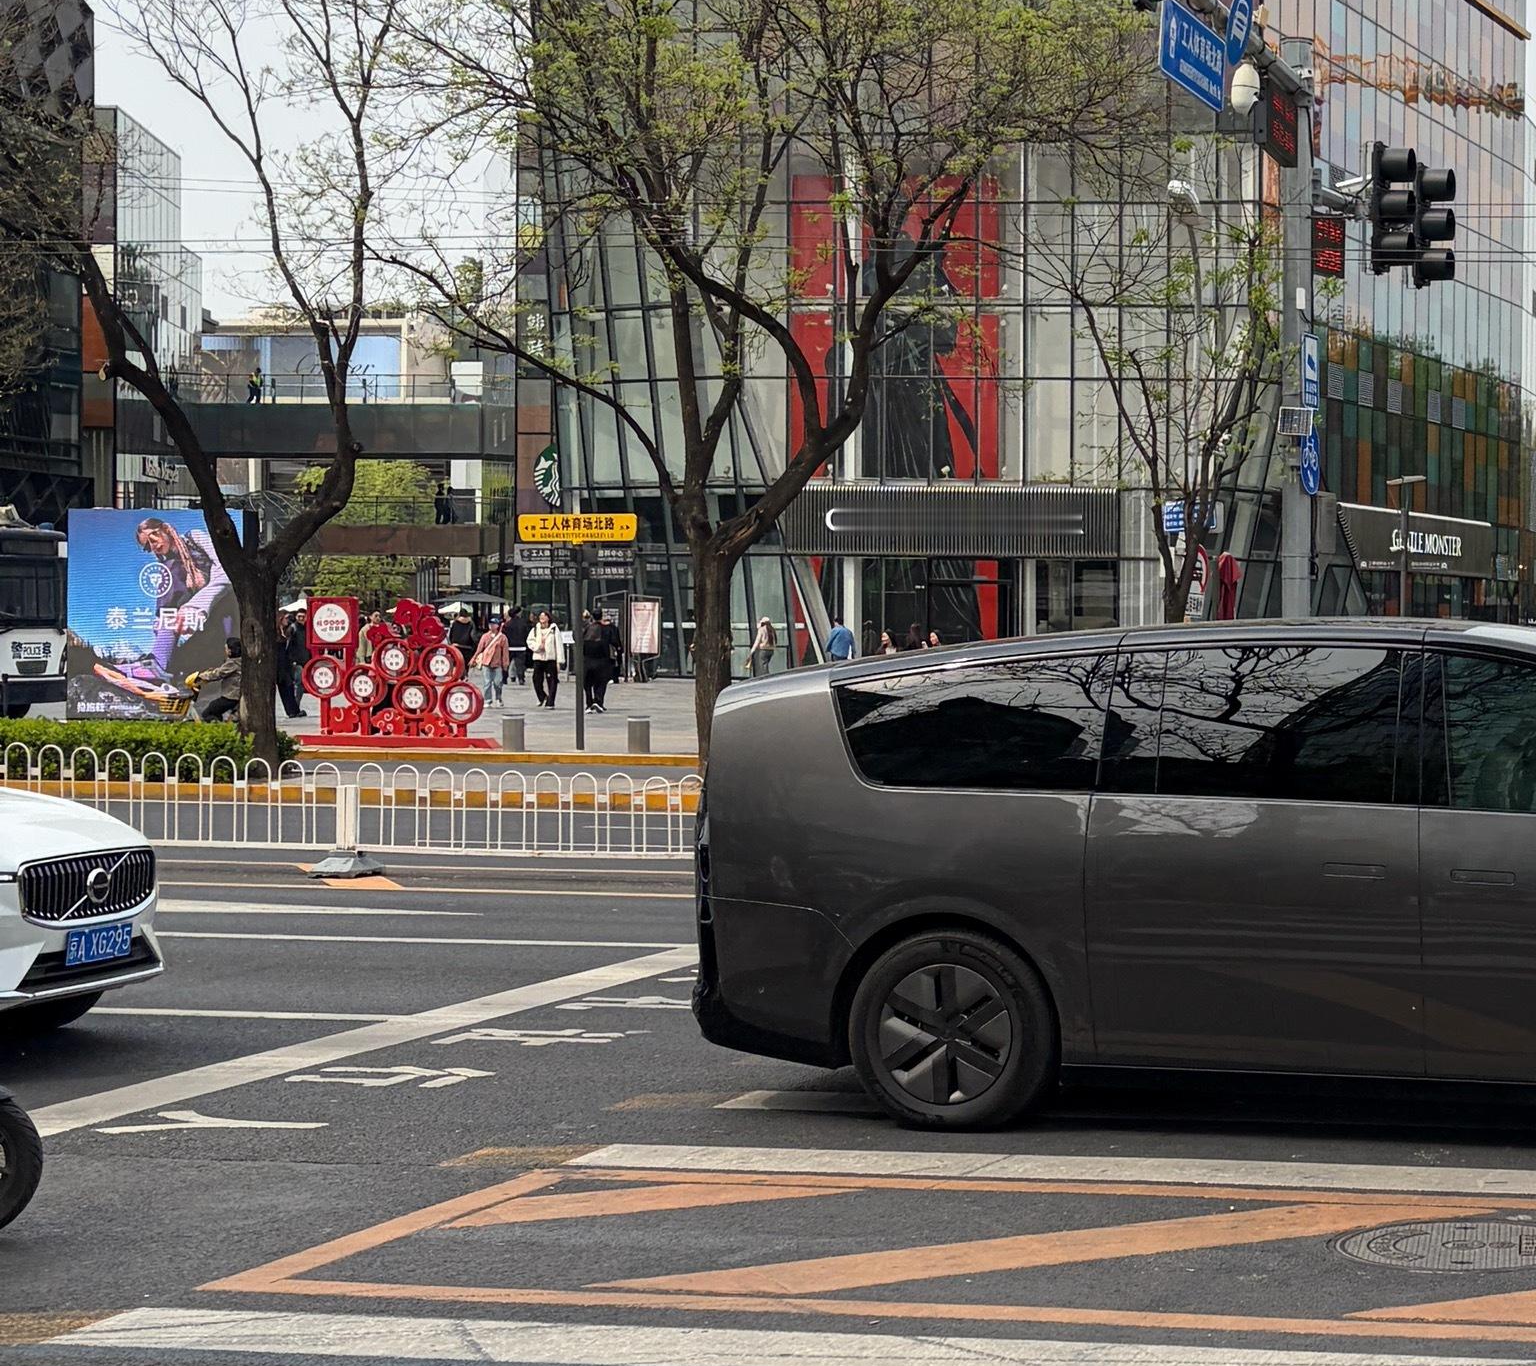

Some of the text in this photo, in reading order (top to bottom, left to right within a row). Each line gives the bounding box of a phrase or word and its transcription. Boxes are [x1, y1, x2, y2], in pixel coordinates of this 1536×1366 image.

[540, 517, 614, 530] 工人体育场北路
[1389, 529, 1462, 557] GETLE MONSTER
[105, 606, 207, 632] 泰兰尼斯
